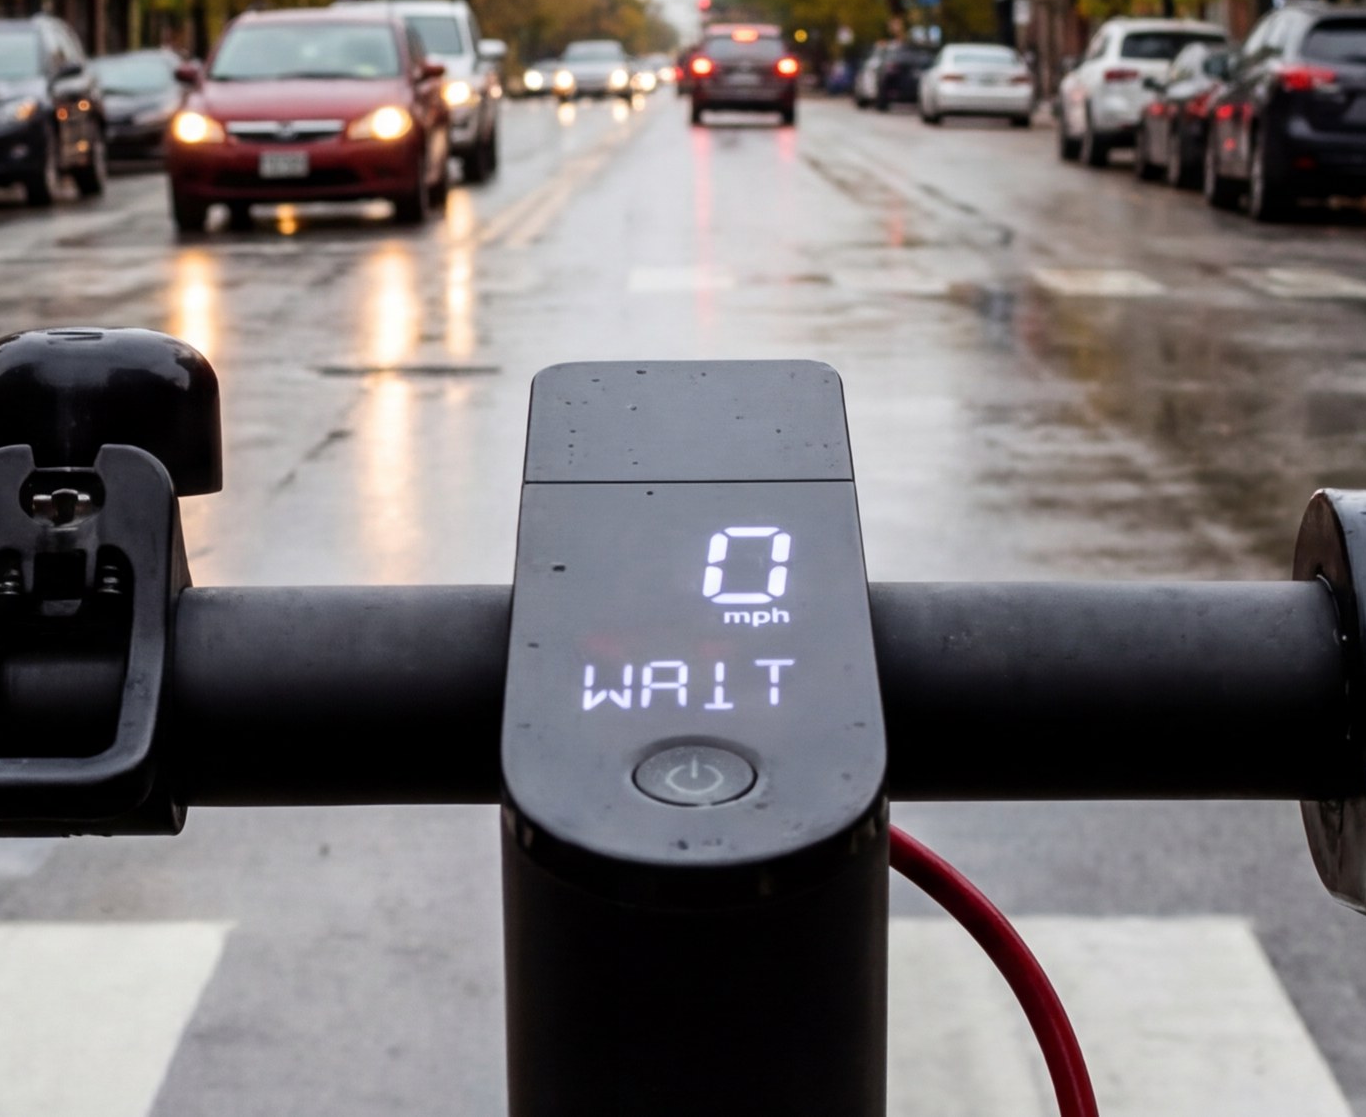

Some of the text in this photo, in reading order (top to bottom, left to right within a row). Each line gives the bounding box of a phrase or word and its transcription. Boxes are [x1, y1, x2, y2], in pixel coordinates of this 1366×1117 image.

[702, 526, 791, 604] 0
[723, 607, 790, 627] mph
[582, 659, 795, 711] WAIT
